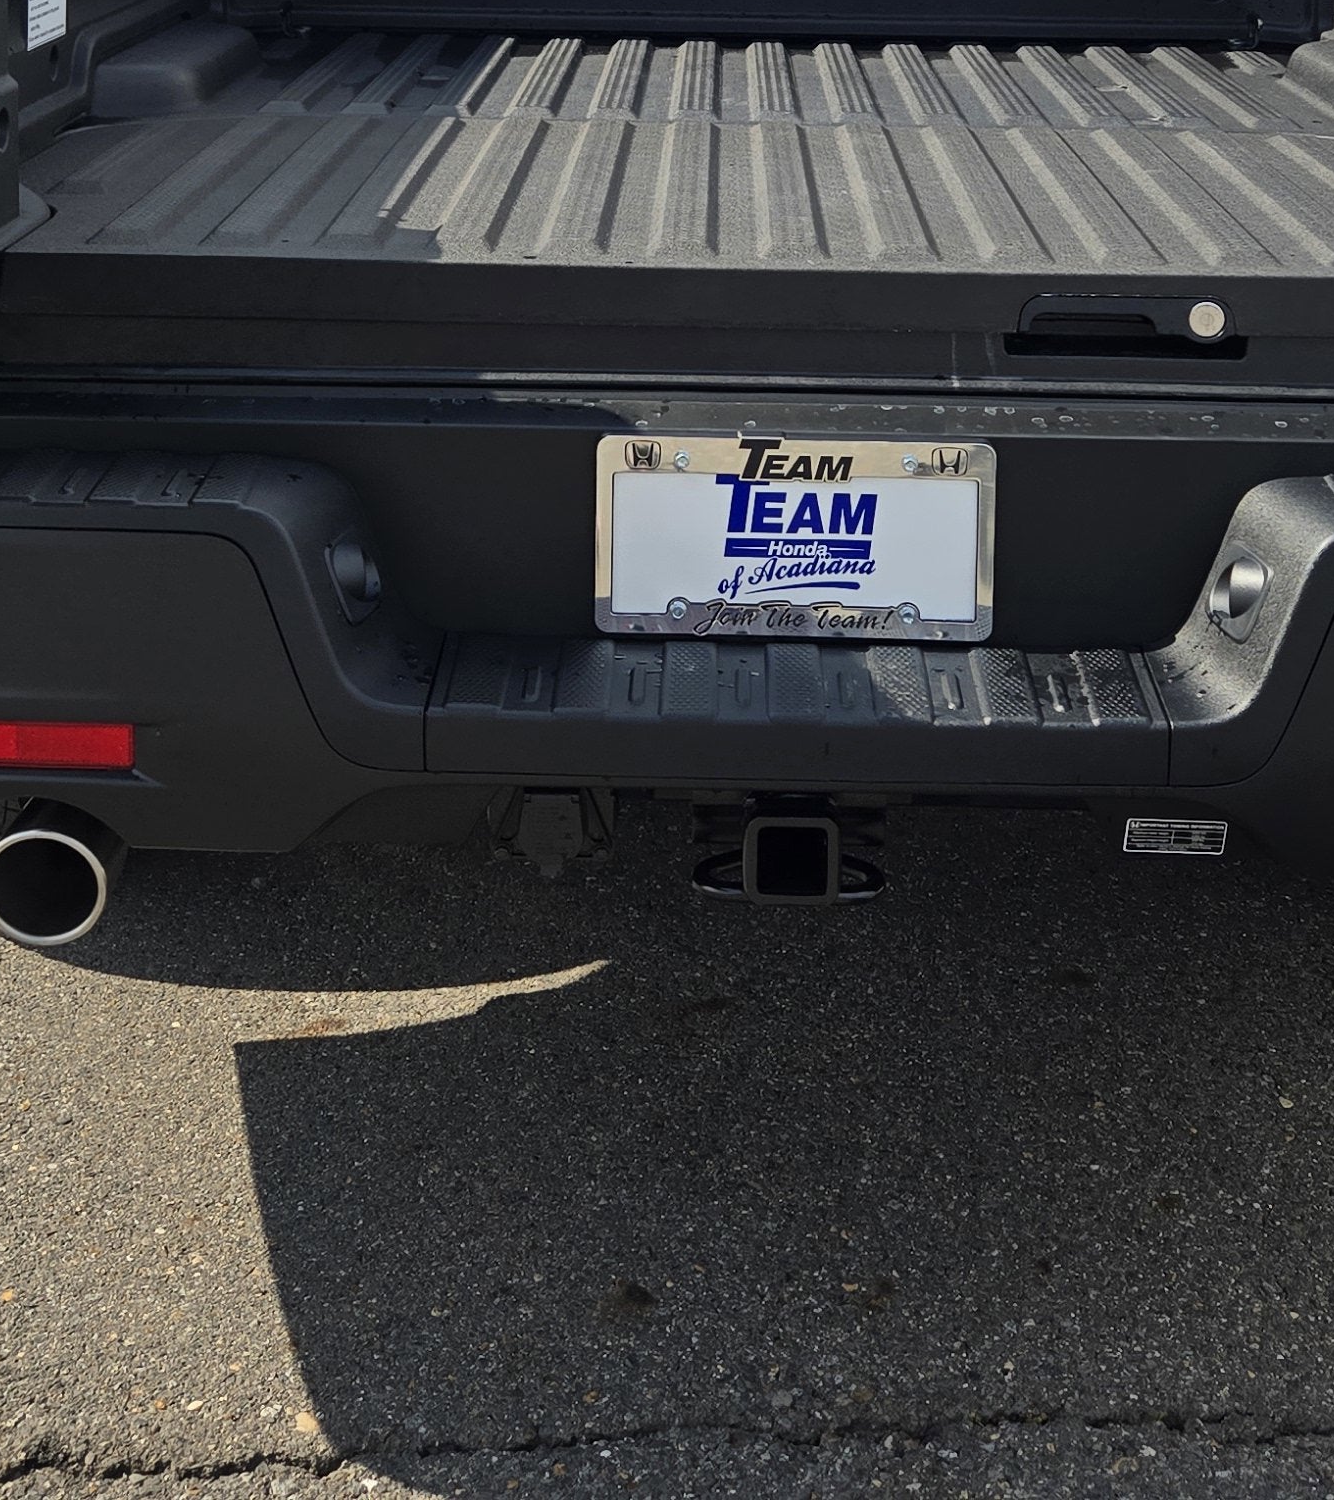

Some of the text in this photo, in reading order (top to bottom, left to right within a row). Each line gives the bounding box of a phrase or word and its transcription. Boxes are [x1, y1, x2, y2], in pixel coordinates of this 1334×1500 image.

[738, 438, 854, 481] TEAM
[715, 473, 878, 536] TEAM
[767, 540, 829, 557] Honda
[717, 552, 877, 600] of Acadiana
[692, 601, 895, 636] Join The Team!
